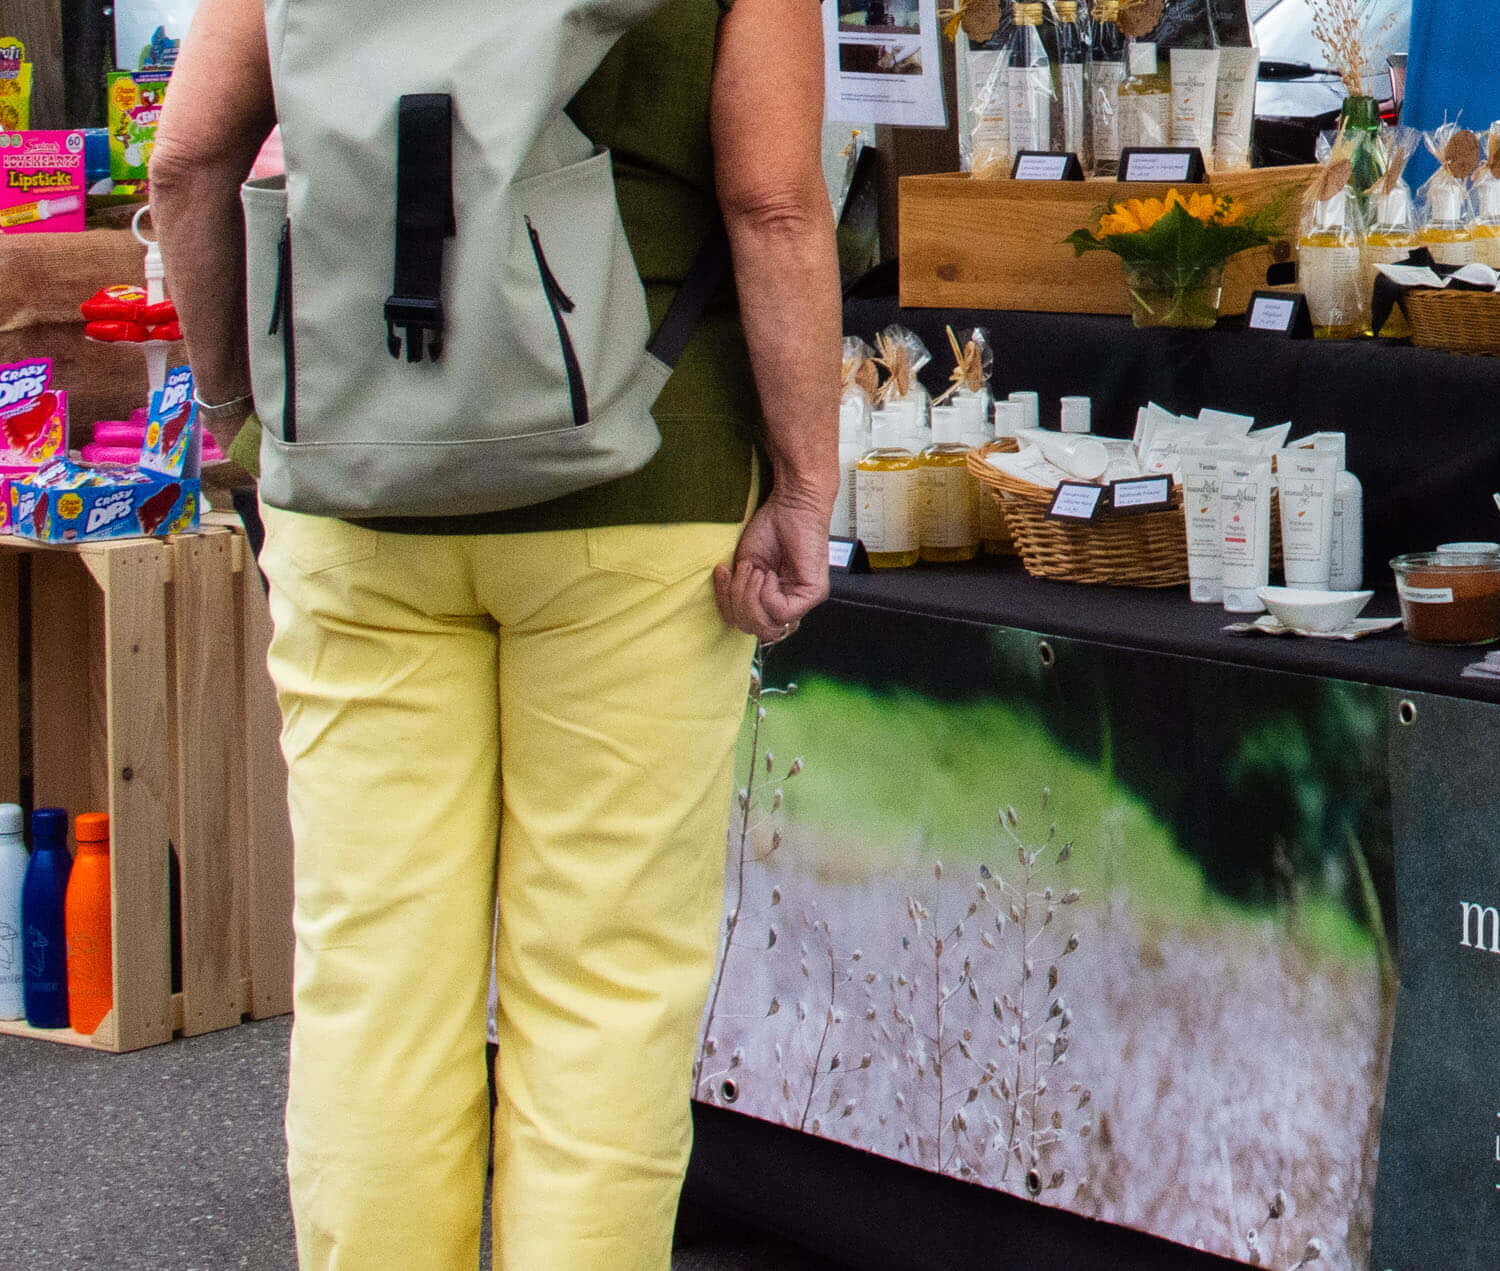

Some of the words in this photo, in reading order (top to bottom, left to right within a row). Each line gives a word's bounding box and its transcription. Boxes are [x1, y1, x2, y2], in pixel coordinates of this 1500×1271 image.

[68, 136, 81, 146] 60
[8, 170, 72, 192] Lipsticks
[1, 364, 47, 382] CRAZY
[0, 375, 48, 407] DIPS
[95, 489, 134, 507] CRAZY
[85, 498, 134, 534] DIPS
